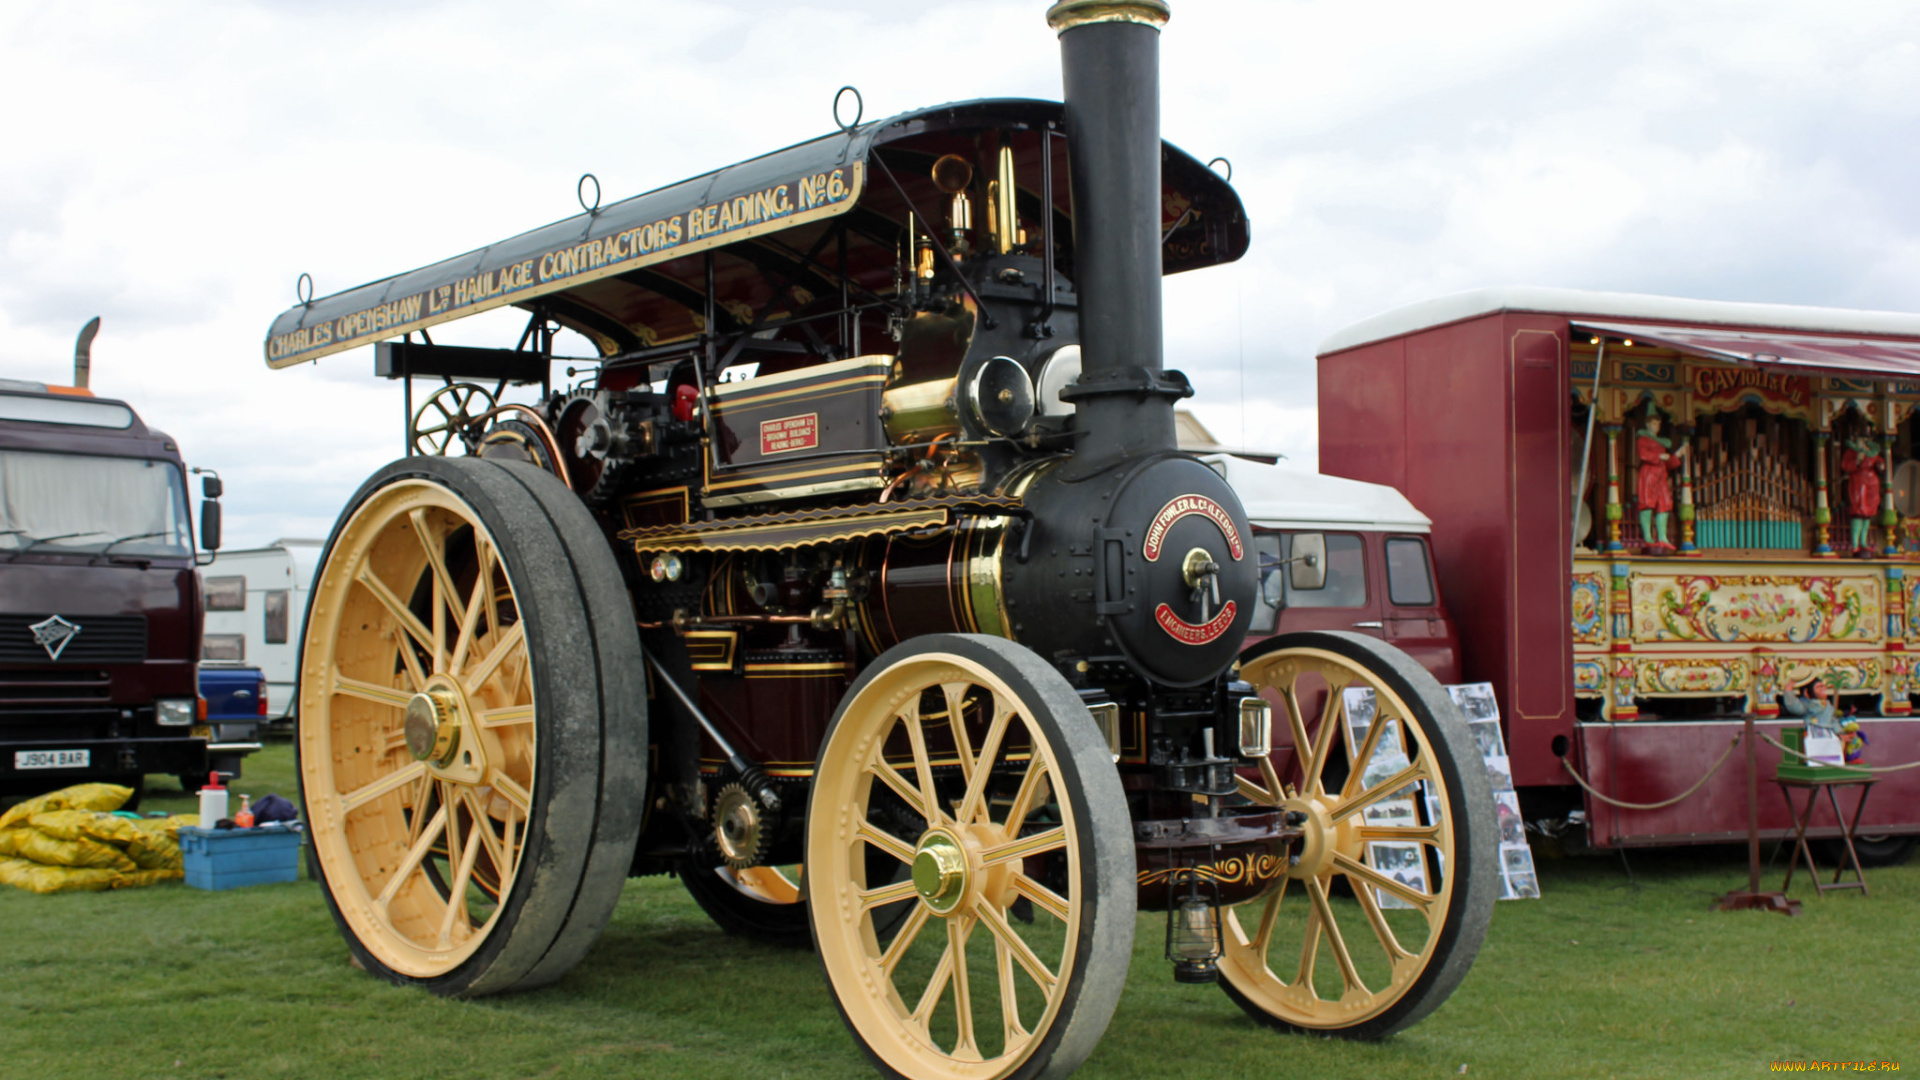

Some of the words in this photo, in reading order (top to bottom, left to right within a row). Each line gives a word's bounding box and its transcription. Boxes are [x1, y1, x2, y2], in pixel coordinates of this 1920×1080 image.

[270, 320, 332, 358] CHARLES
[337, 294, 423, 342] OPENSHAW
[454, 260, 534, 305] HAULAGE
[539, 215, 683, 281] CONTRACTORS
[1148, 522, 1164, 553] JOHN
[1159, 499, 1190, 527] FOWLER
[1208, 608, 1233, 636] LEEDS
[21, 753, 54, 766] J904
[58, 752, 83, 765] BAR
